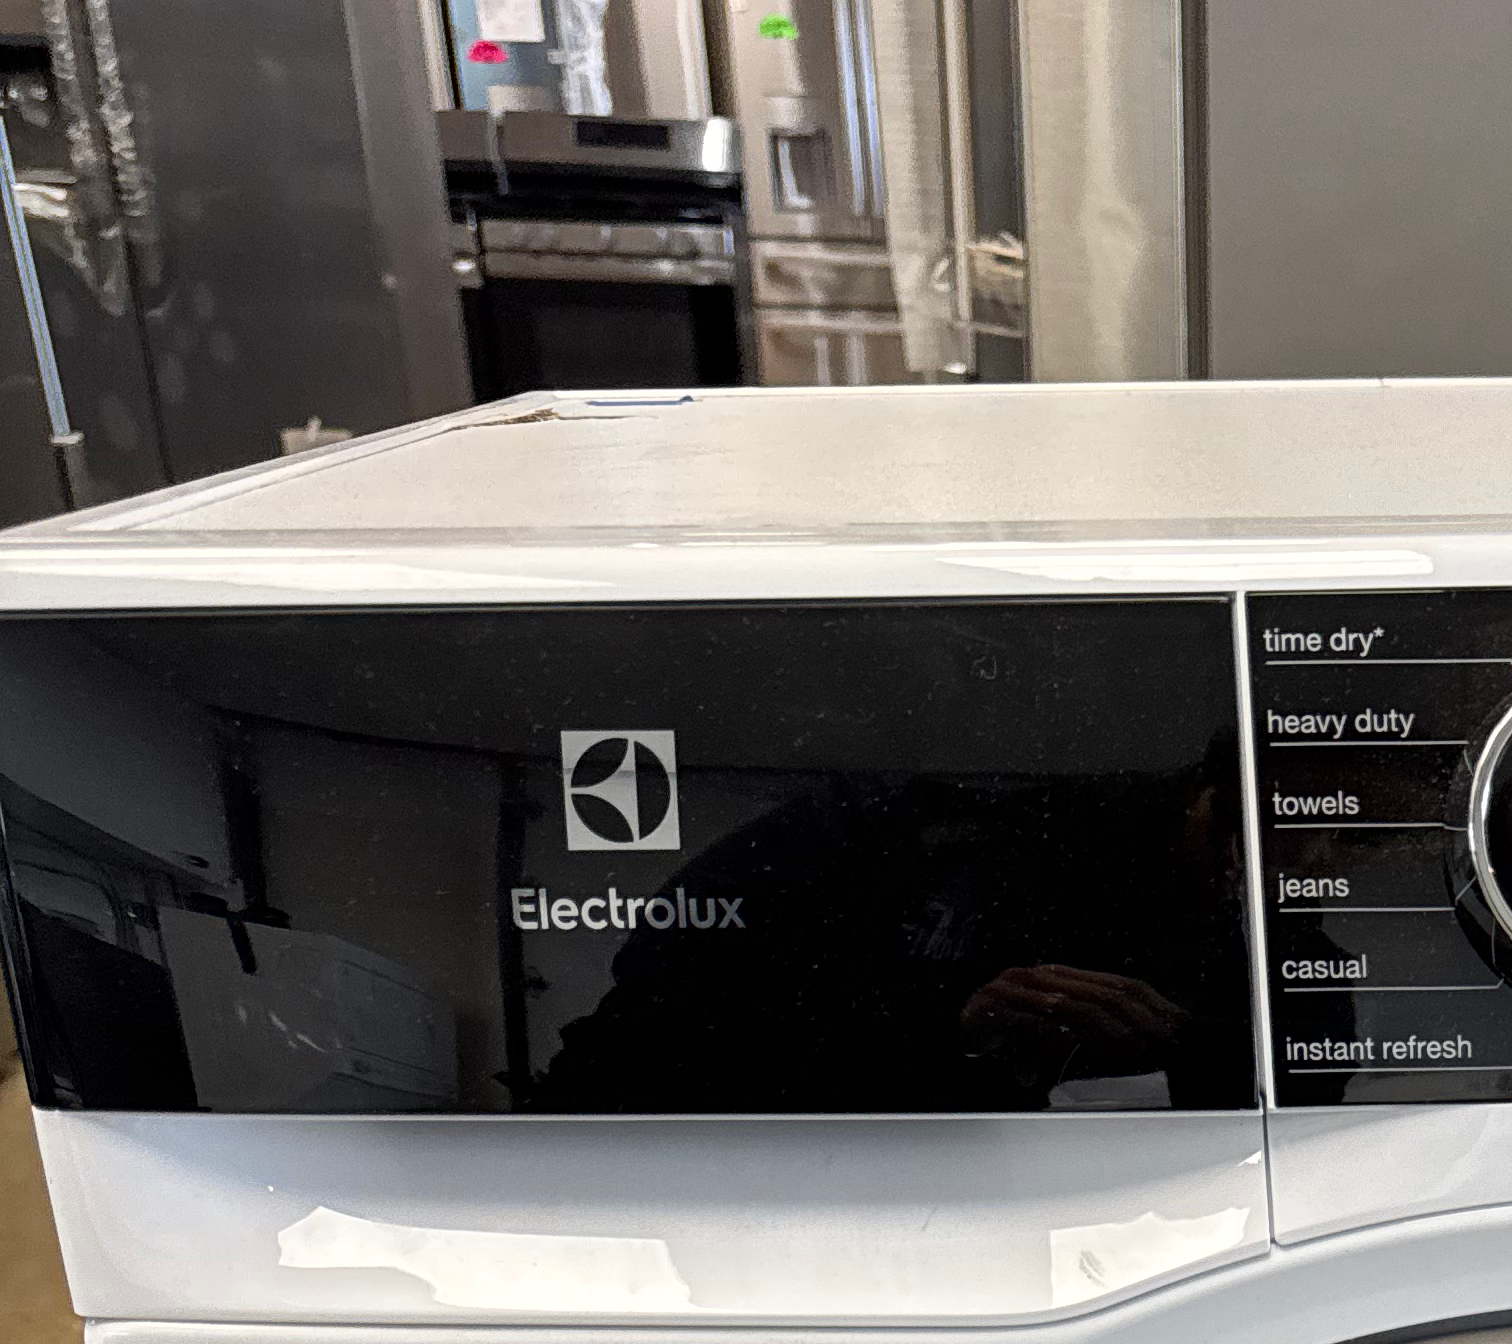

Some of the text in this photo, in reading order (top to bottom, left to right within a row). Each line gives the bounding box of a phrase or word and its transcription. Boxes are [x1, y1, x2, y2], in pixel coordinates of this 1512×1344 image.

[1263, 630, 1321, 651] time
[1268, 708, 1414, 739] heavy duty
[1272, 791, 1359, 815] towels
[1278, 873, 1349, 903] jeans
[512, 886, 746, 930] Electrolux
[1282, 954, 1367, 979] casual
[1287, 1035, 1471, 1060] instant refresh
